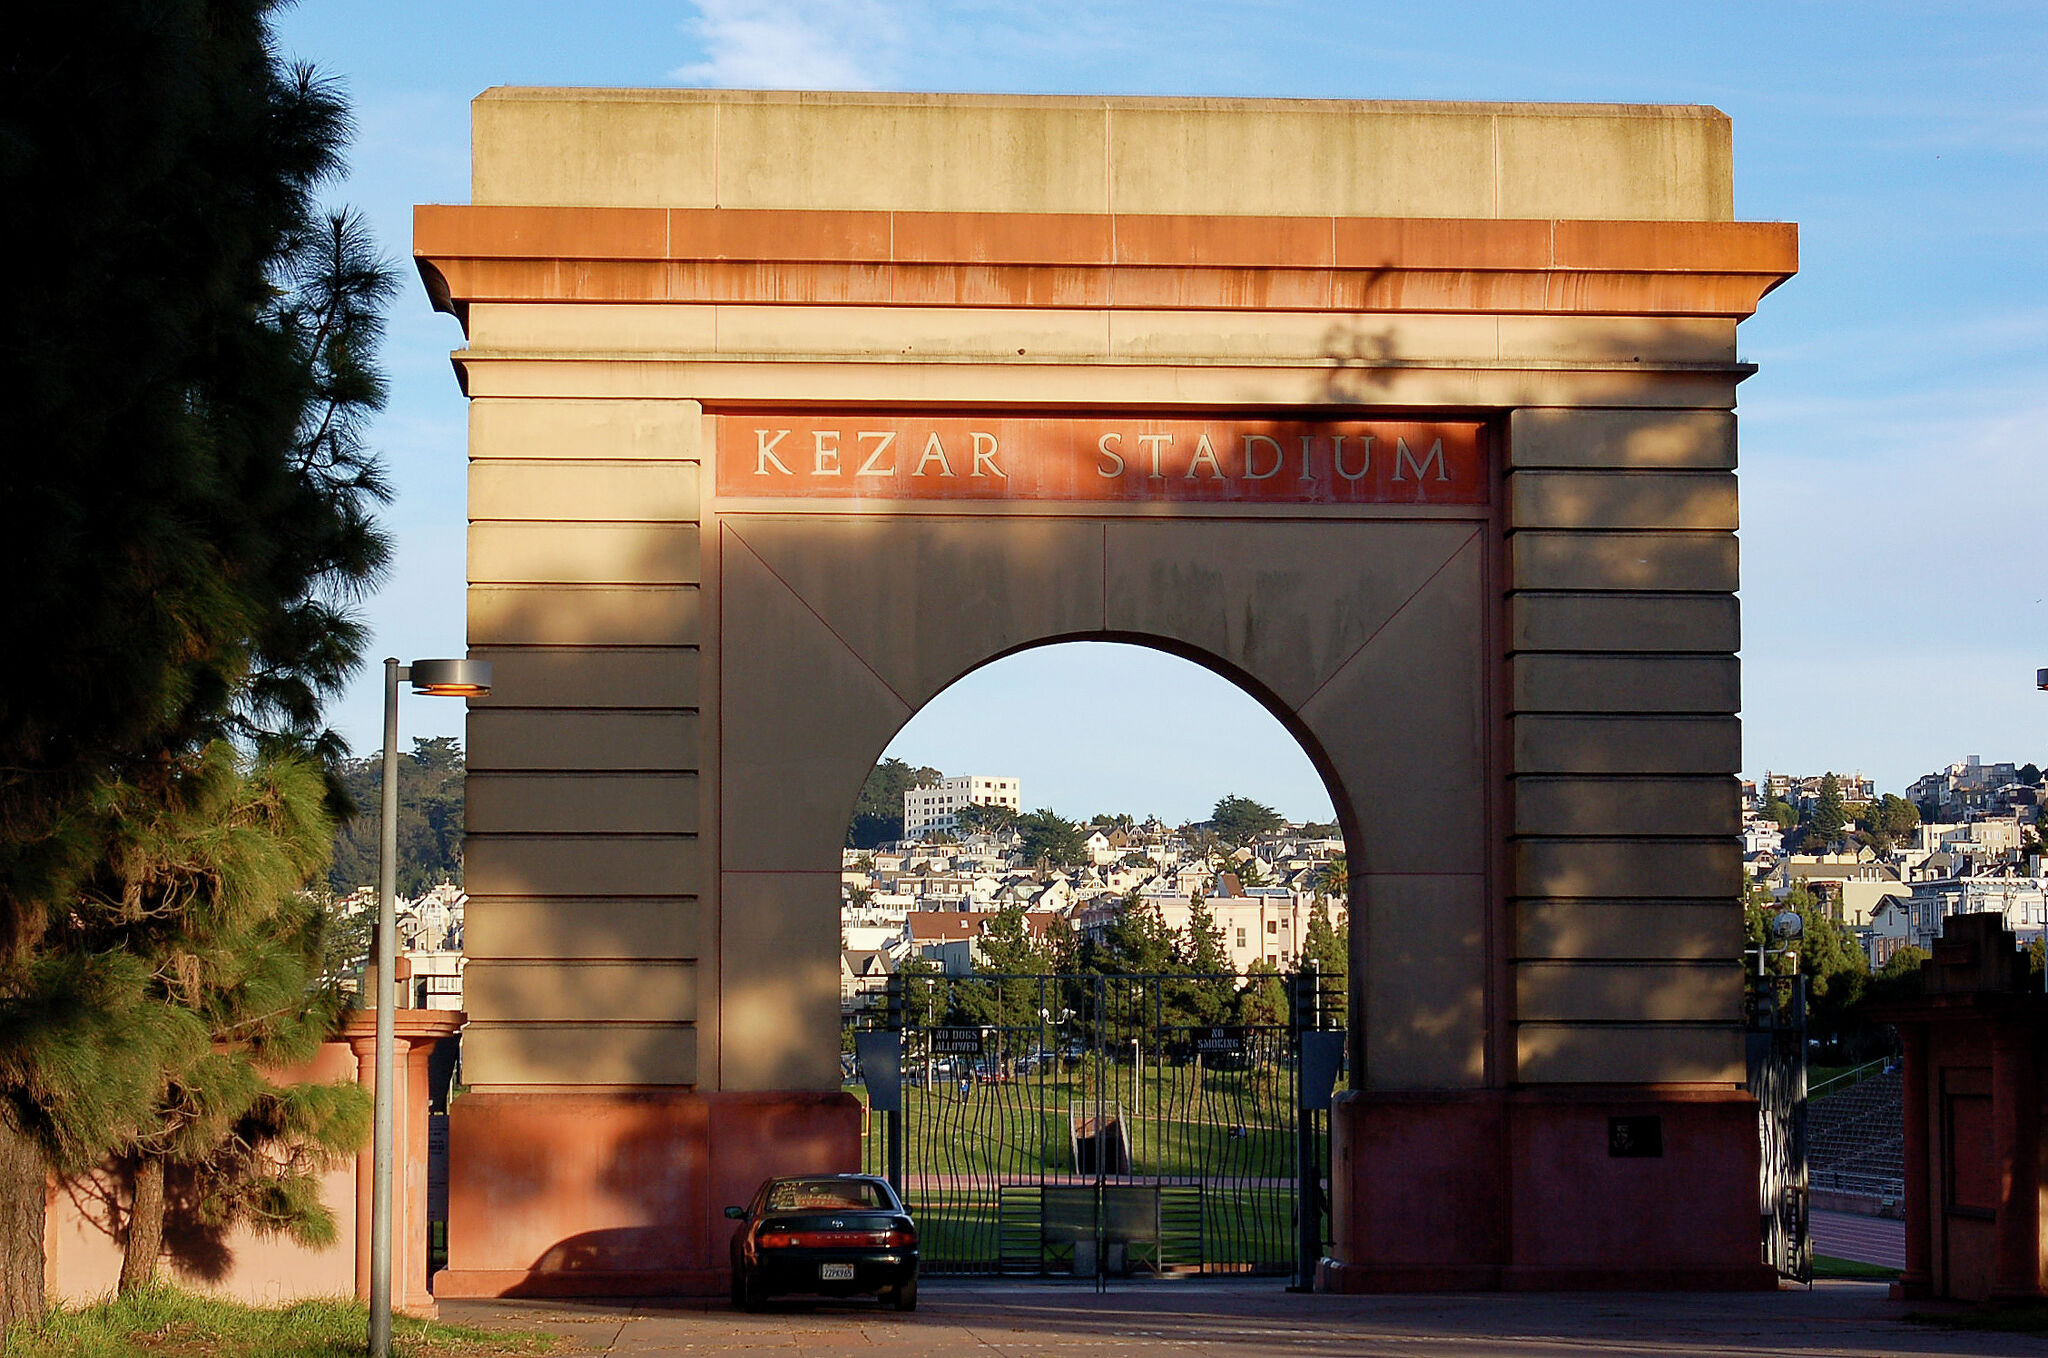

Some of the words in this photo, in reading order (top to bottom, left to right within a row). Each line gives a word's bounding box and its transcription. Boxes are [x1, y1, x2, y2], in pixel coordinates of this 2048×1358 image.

[753, 428, 1009, 479] KEZAR
[1097, 432, 1452, 482] STADIUM
[936, 1030, 949, 1040] NO
[952, 1030, 978, 1040] DOGS
[1211, 1028, 1224, 1038] NO
[936, 1041, 978, 1051] ALLOWED
[1197, 1039, 1239, 1049] SMOKING
